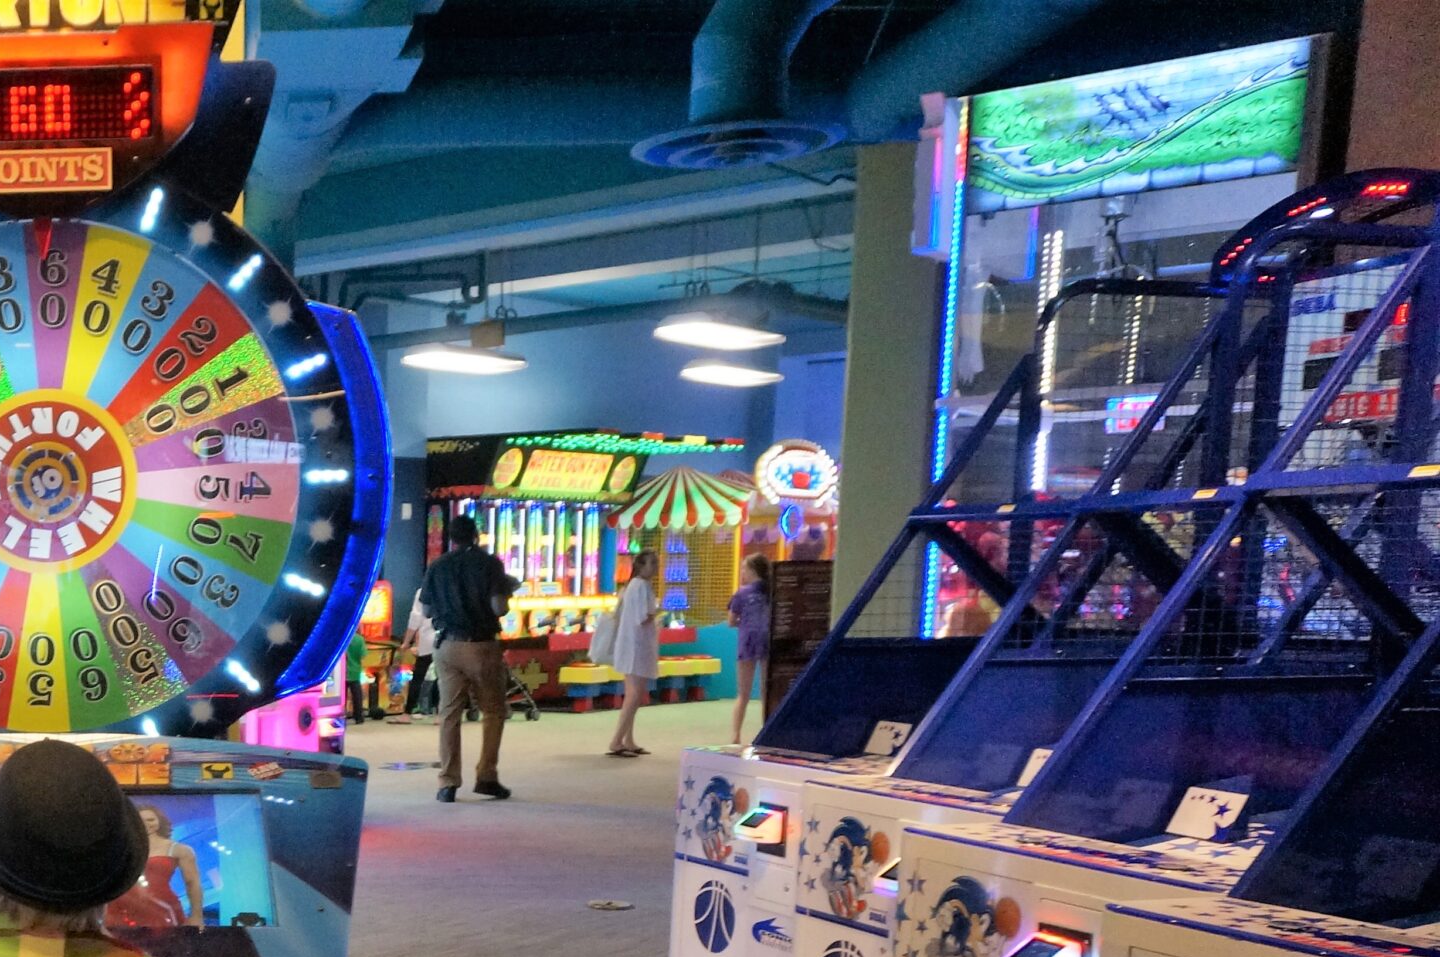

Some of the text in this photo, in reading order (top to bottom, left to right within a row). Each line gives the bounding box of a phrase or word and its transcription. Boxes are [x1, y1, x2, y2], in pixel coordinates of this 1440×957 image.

[9, 84, 71, 133] 60
[38, 249, 69, 329] 60
[83, 258, 121, 336] 40
[121, 279, 175, 353] 30
[153, 316, 218, 382] 20
[143, 365, 250, 435] 100
[2, 465, 122, 559] WHEEL
[196, 470, 272, 504] 45
[188, 516, 265, 563] 70
[169, 554, 241, 609] 30
[91, 579, 161, 685] 500
[27, 633, 56, 707] 50
